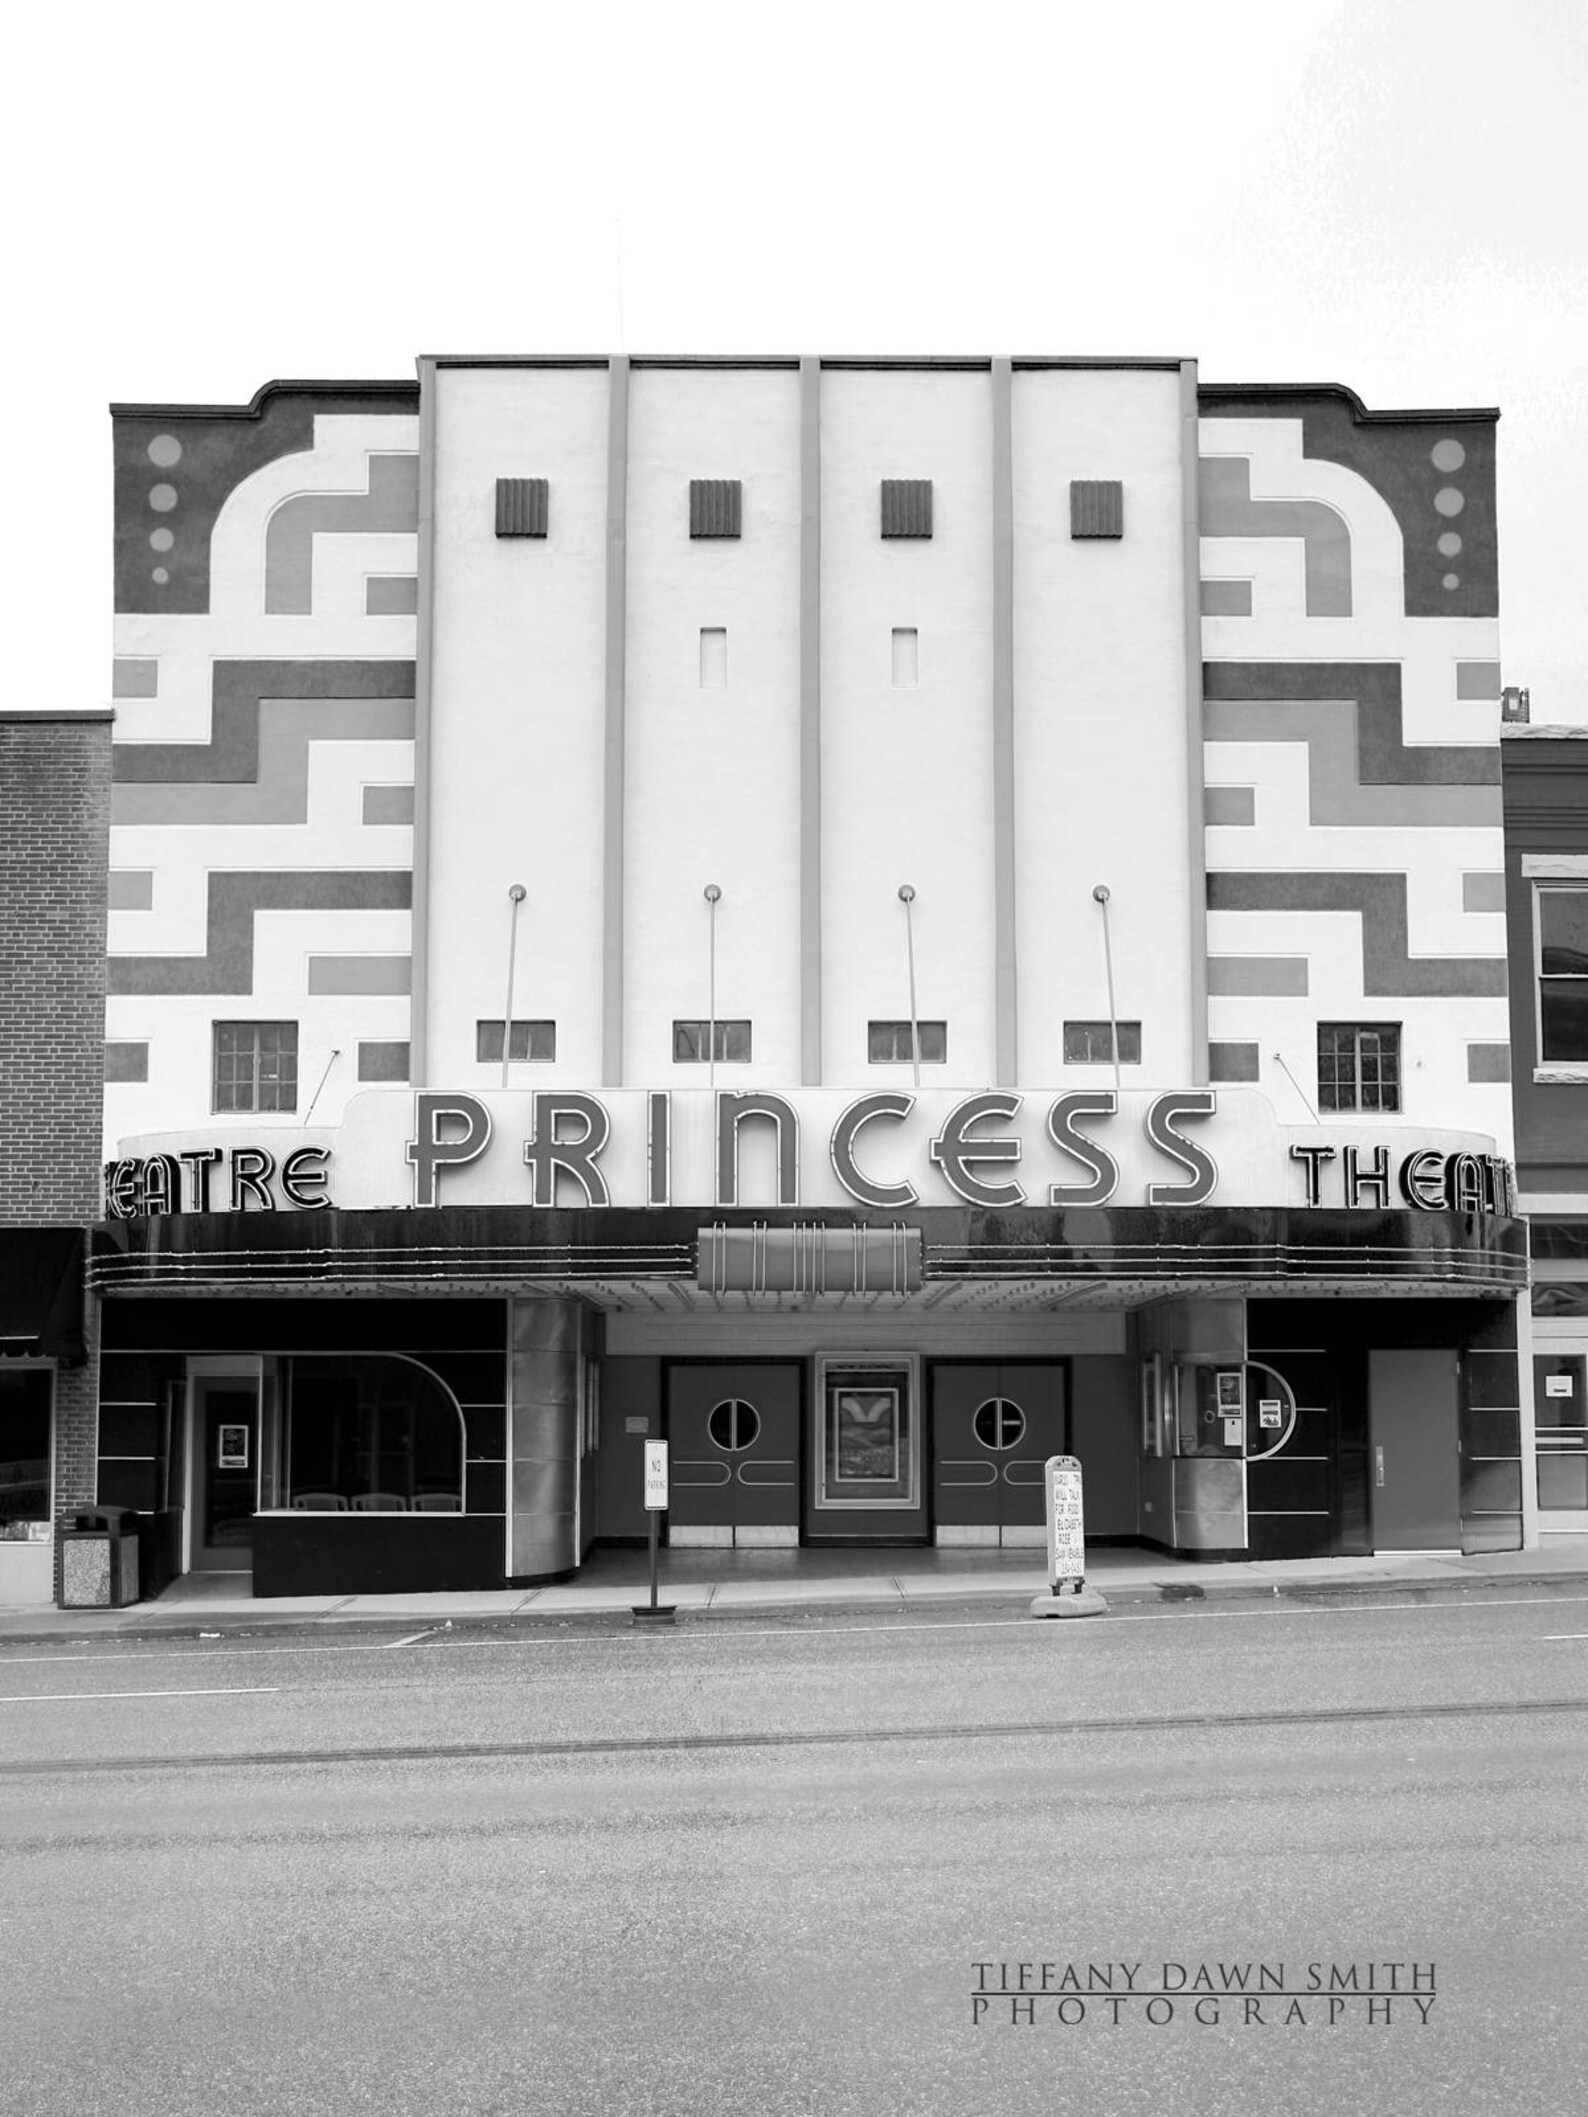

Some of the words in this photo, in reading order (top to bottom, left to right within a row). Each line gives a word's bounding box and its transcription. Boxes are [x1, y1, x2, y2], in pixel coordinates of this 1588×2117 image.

[105, 1145, 333, 1219] EATRE
[405, 1089, 1218, 1209] PRINCESS
[651, 1460, 661, 1472] NO
